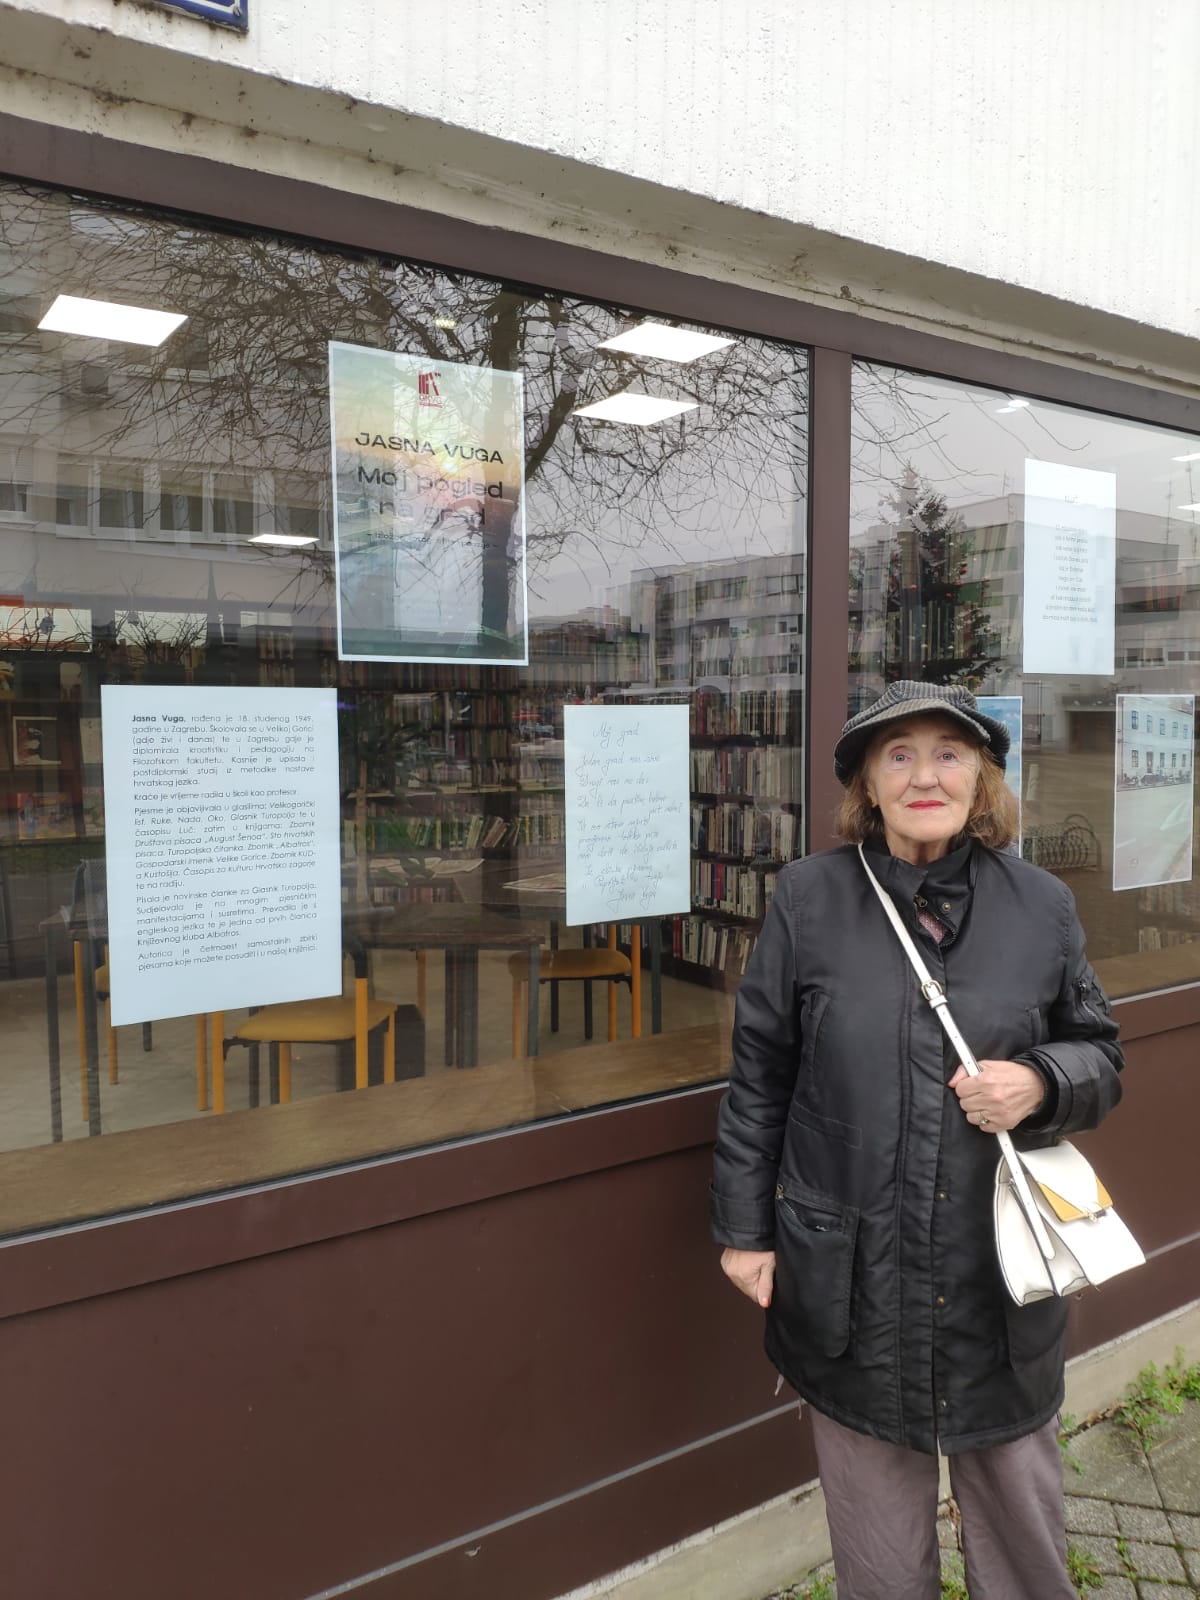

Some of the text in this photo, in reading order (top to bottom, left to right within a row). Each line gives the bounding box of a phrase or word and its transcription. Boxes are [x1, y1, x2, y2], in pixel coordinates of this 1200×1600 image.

[355, 432, 504, 464] JASNA VUGA
[358, 466, 503, 499] Moj pogled
[131, 714, 157, 722] Jasna
[161, 714, 186, 724] Vuga,
[225, 714, 233, 723] je
[254, 715, 290, 724] studenog
[209, 724, 247, 733] Školovala
[266, 724, 291, 733] Velikoj
[160, 736, 173, 744] živi
[222, 735, 230, 743] te
[247, 735, 279, 744] Zagrebu
[285, 736, 302, 744] gdje
[307, 736, 314, 744] je
[132, 746, 179, 755] diplomirala
[189, 746, 229, 754] kroatistiku
[250, 745, 295, 754] pedagogiju
[132, 757, 179, 765] Filozofskom
[231, 755, 258, 764] Kasnije
[279, 755, 306, 763] upisala
[133, 767, 188, 778] postdiplomski
[197, 767, 218, 776] studij
[240, 765, 277, 774] metodike
[133, 779, 174, 788] hrvatskog
[160, 793, 168, 802] je
[170, 792, 200, 800] vrijeme
[201, 790, 224, 799] radila
[250, 789, 265, 797] kao
[134, 807, 164, 817] Pjesme
[166, 806, 174, 815] je
[176, 804, 222, 814] objavljivala
[269, 800, 316, 810] Velikogorički
[230, 813, 258, 821] Glasnik
[262, 812, 296, 820] Turopolja
[135, 827, 171, 837] časopisu
[204, 824, 226, 833] zatim
[174, 837, 202, 846] pisaca
[283, 830, 315, 838] hrvatskih
[247, 842, 274, 851] Zbornik
[135, 858, 187, 869] Gospodarski
[188, 856, 214, 865] imenik
[216, 855, 239, 863] Velike
[270, 851, 297, 860] Zbornik
[183, 867, 215, 876] Časopis
[228, 864, 254, 872] kulturu
[255, 862, 287, 870] Hrvatsko
[289, 861, 316, 869] zagorje
[136, 882, 145, 890] te
[136, 895, 160, 904] Pisala
[162, 895, 170, 903] je
[173, 891, 208, 901] novinske
[210, 890, 238, 898] članke
[251, 886, 278, 894] Glasnik
[136, 903, 184, 915] Sudjelovala
[195, 901, 203, 911] je
[236, 898, 268, 906] mnogim
[279, 892, 317, 903] pjesničkim
[137, 913, 205, 925] manifestacijama
[262, 905, 297, 913] Prevodila
[137, 925, 179, 936] engleskog
[182, 922, 205, 932] jezika
[218, 921, 226, 929] je
[228, 919, 252, 928] jedna
[255, 916, 266, 924] od
[268, 914, 287, 925] prvih
[289, 912, 317, 921] članica
[137, 936, 181, 947] Književnog
[182, 933, 205, 941] kluba
[137, 934, 318, 960] Autorica je četrnaest samostalnih zbirki
[138, 961, 174, 972] pjesama
[175, 958, 192, 967] koje
[193, 955, 223, 964] možete
[225, 951, 256, 961] posuditi
[267, 947, 287, 956] našoj
